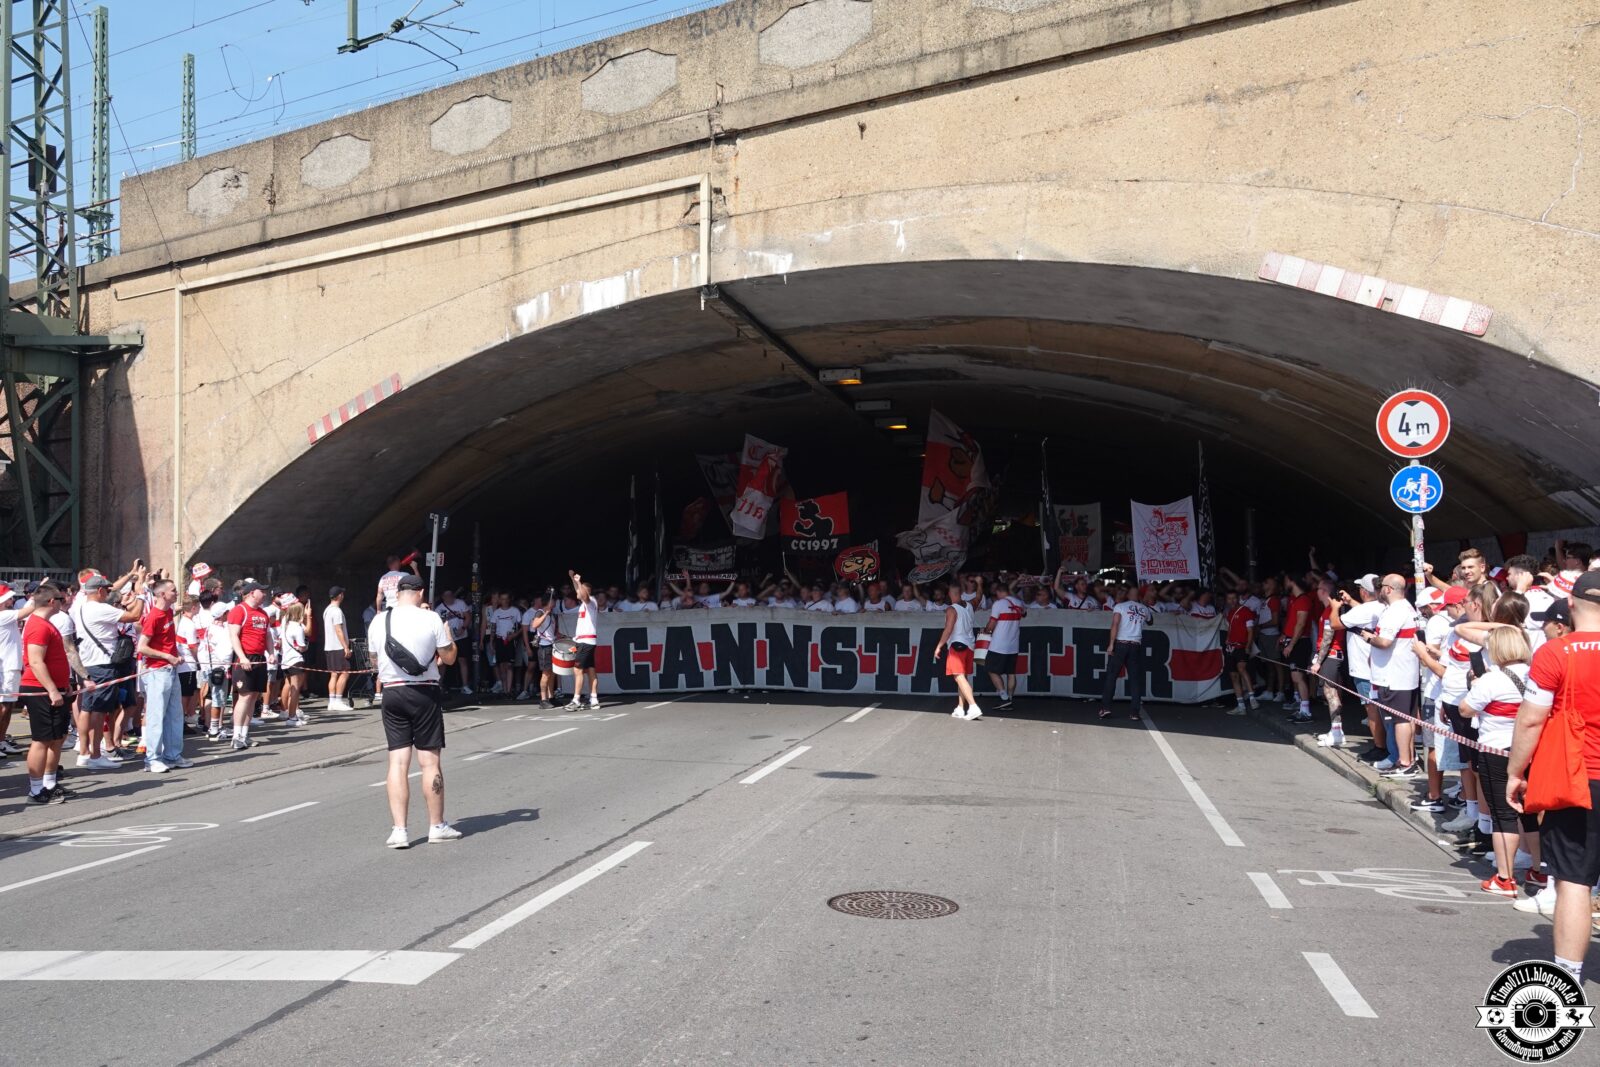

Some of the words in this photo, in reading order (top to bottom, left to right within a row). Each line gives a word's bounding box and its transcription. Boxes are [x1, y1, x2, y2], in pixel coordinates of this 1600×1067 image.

[1398, 412, 1411, 436] 4
[1416, 422, 1430, 435] m
[791, 538, 838, 551] CC1997
[613, 622, 1173, 698] CANNSTATER
